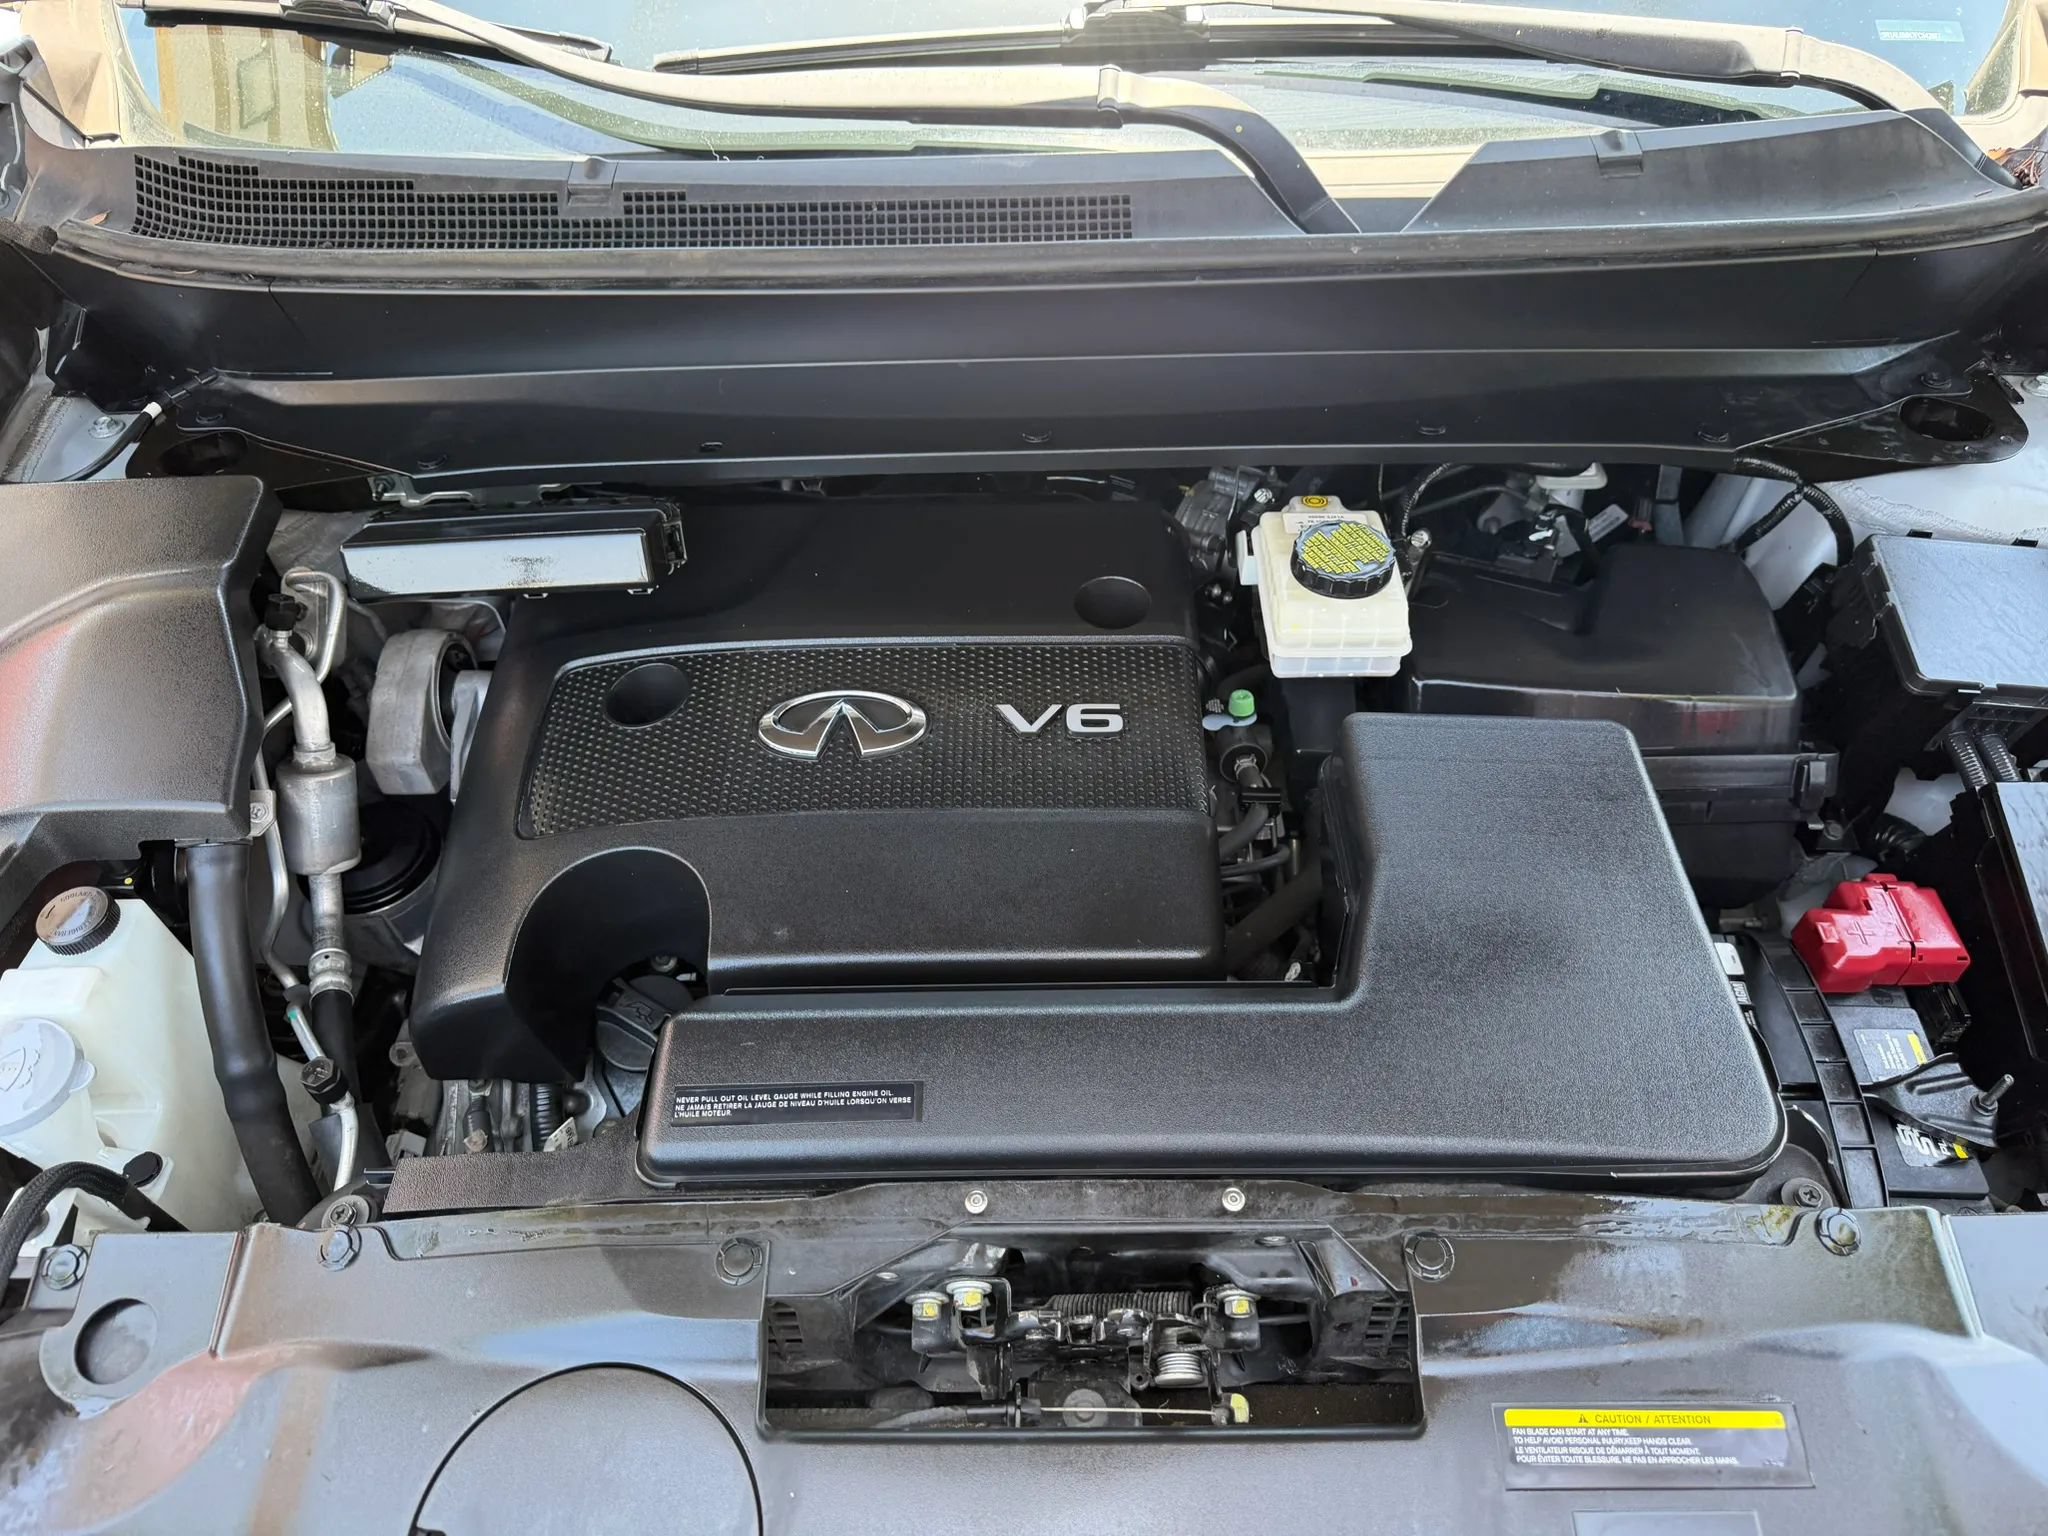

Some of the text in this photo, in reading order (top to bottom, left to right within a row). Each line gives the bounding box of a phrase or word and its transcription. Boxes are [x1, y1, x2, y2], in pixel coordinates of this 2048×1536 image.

[995, 703, 1124, 736] V6
[674, 1110, 700, 1118] L'HUILE
[1595, 1414, 1642, 1424] CAUTION
[1654, 1415, 1712, 1424] ATTENTION
